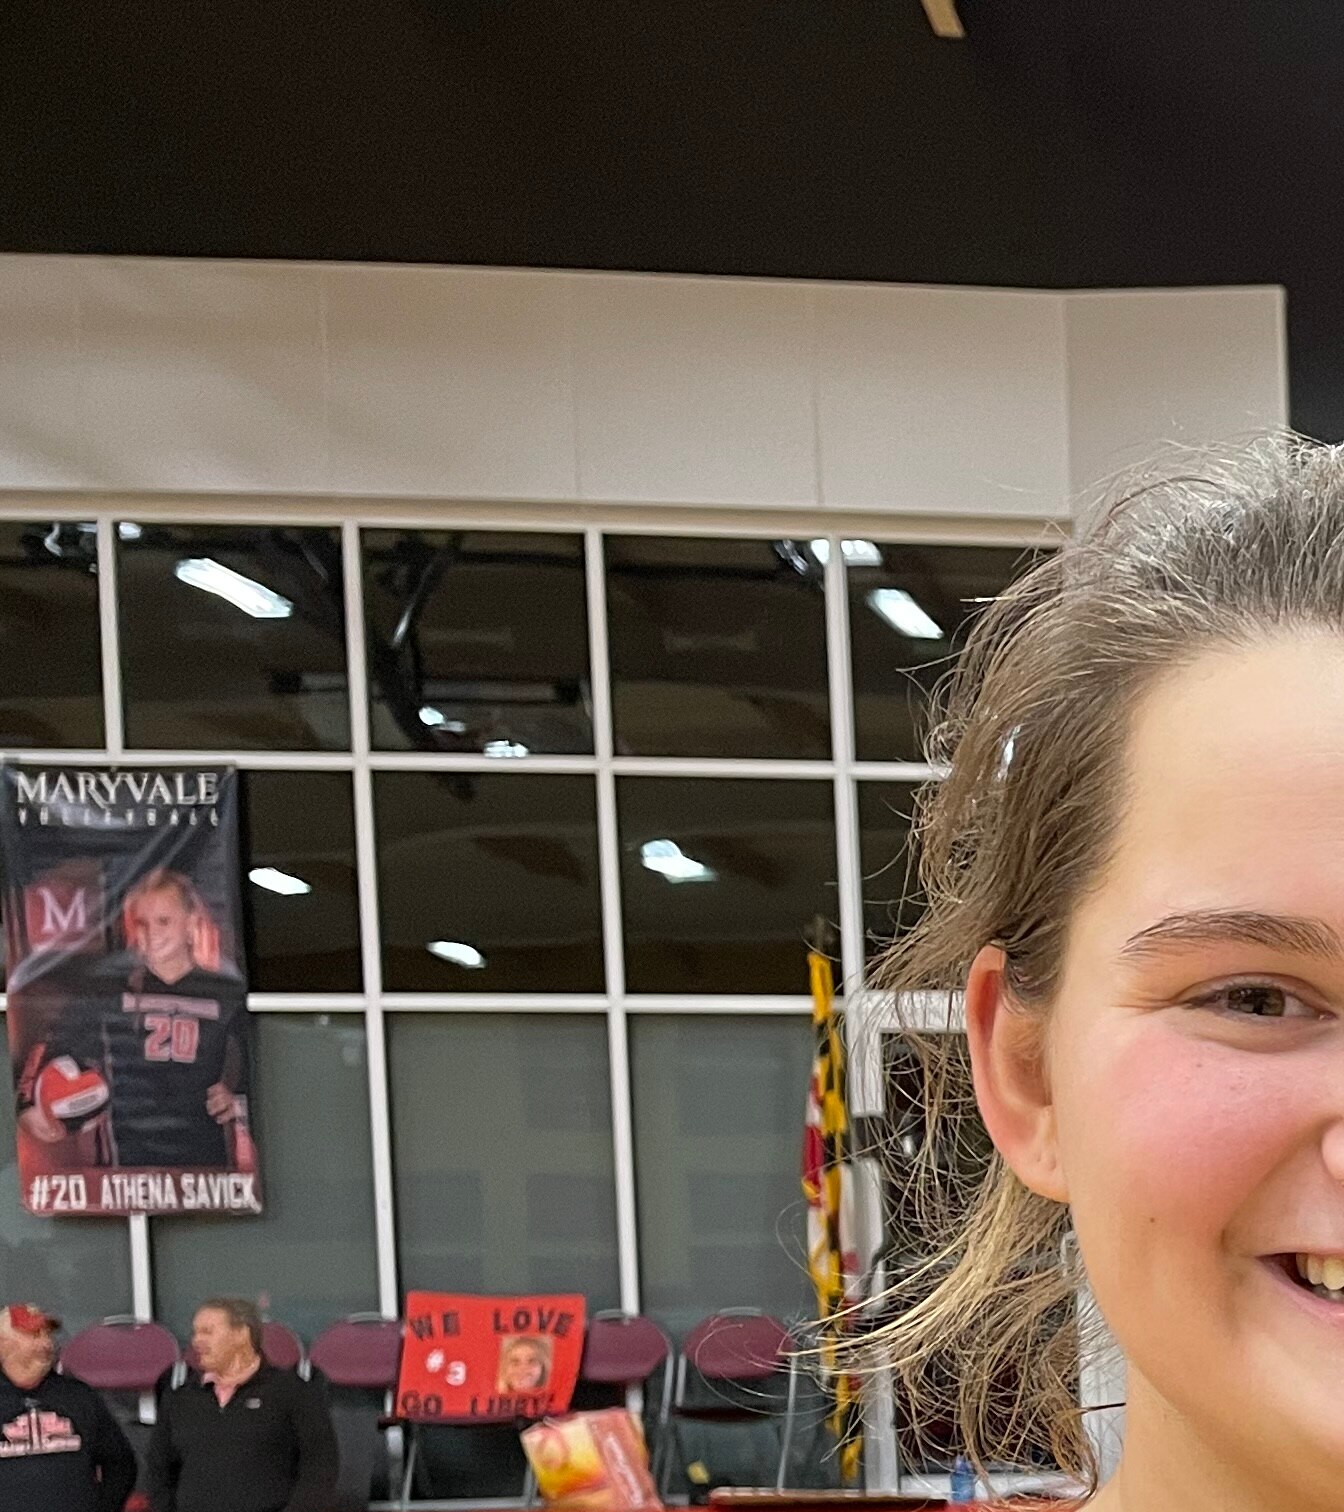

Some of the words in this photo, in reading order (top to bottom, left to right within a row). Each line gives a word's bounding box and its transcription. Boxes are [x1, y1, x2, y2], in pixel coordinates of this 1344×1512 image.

[17, 771, 219, 809] MARYVALE
[144, 1013, 199, 1064] 20
[31, 1173, 87, 1210] #20
[101, 1173, 178, 1209] ATHENA
[180, 1172, 258, 1210] SAVICK
[409, 1311, 461, 1341] WE
[492, 1305, 575, 1337] LOVE
[400, 1389, 443, 1416] GO
